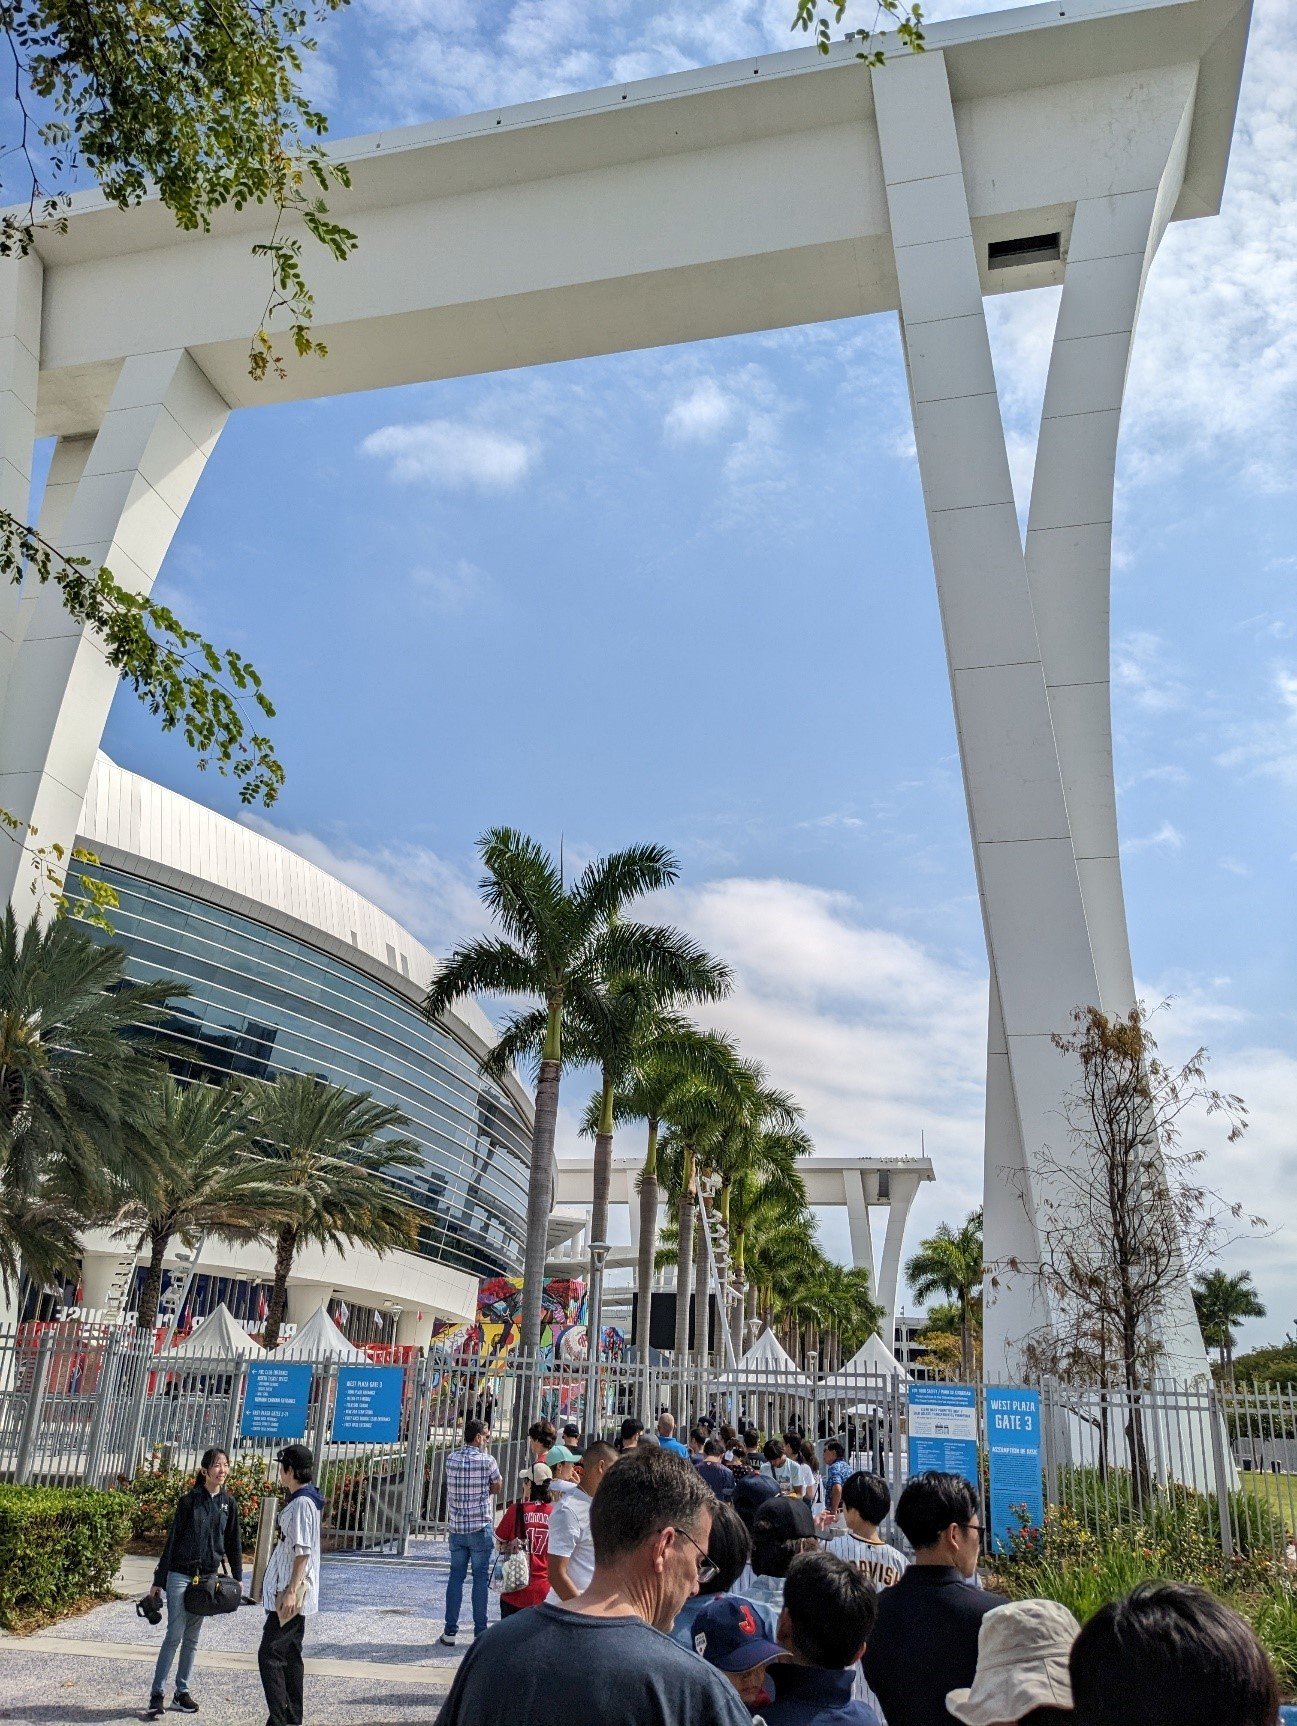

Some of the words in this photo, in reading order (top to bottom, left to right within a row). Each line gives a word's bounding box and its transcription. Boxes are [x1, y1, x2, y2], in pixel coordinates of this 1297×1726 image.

[991, 1399, 1010, 1410] WEST
[1013, 1401, 1035, 1412] PLAZA
[995, 1414, 1021, 1430] GATE
[1024, 1416, 1032, 1430] 3
[526, 1527, 549, 1554] 17
